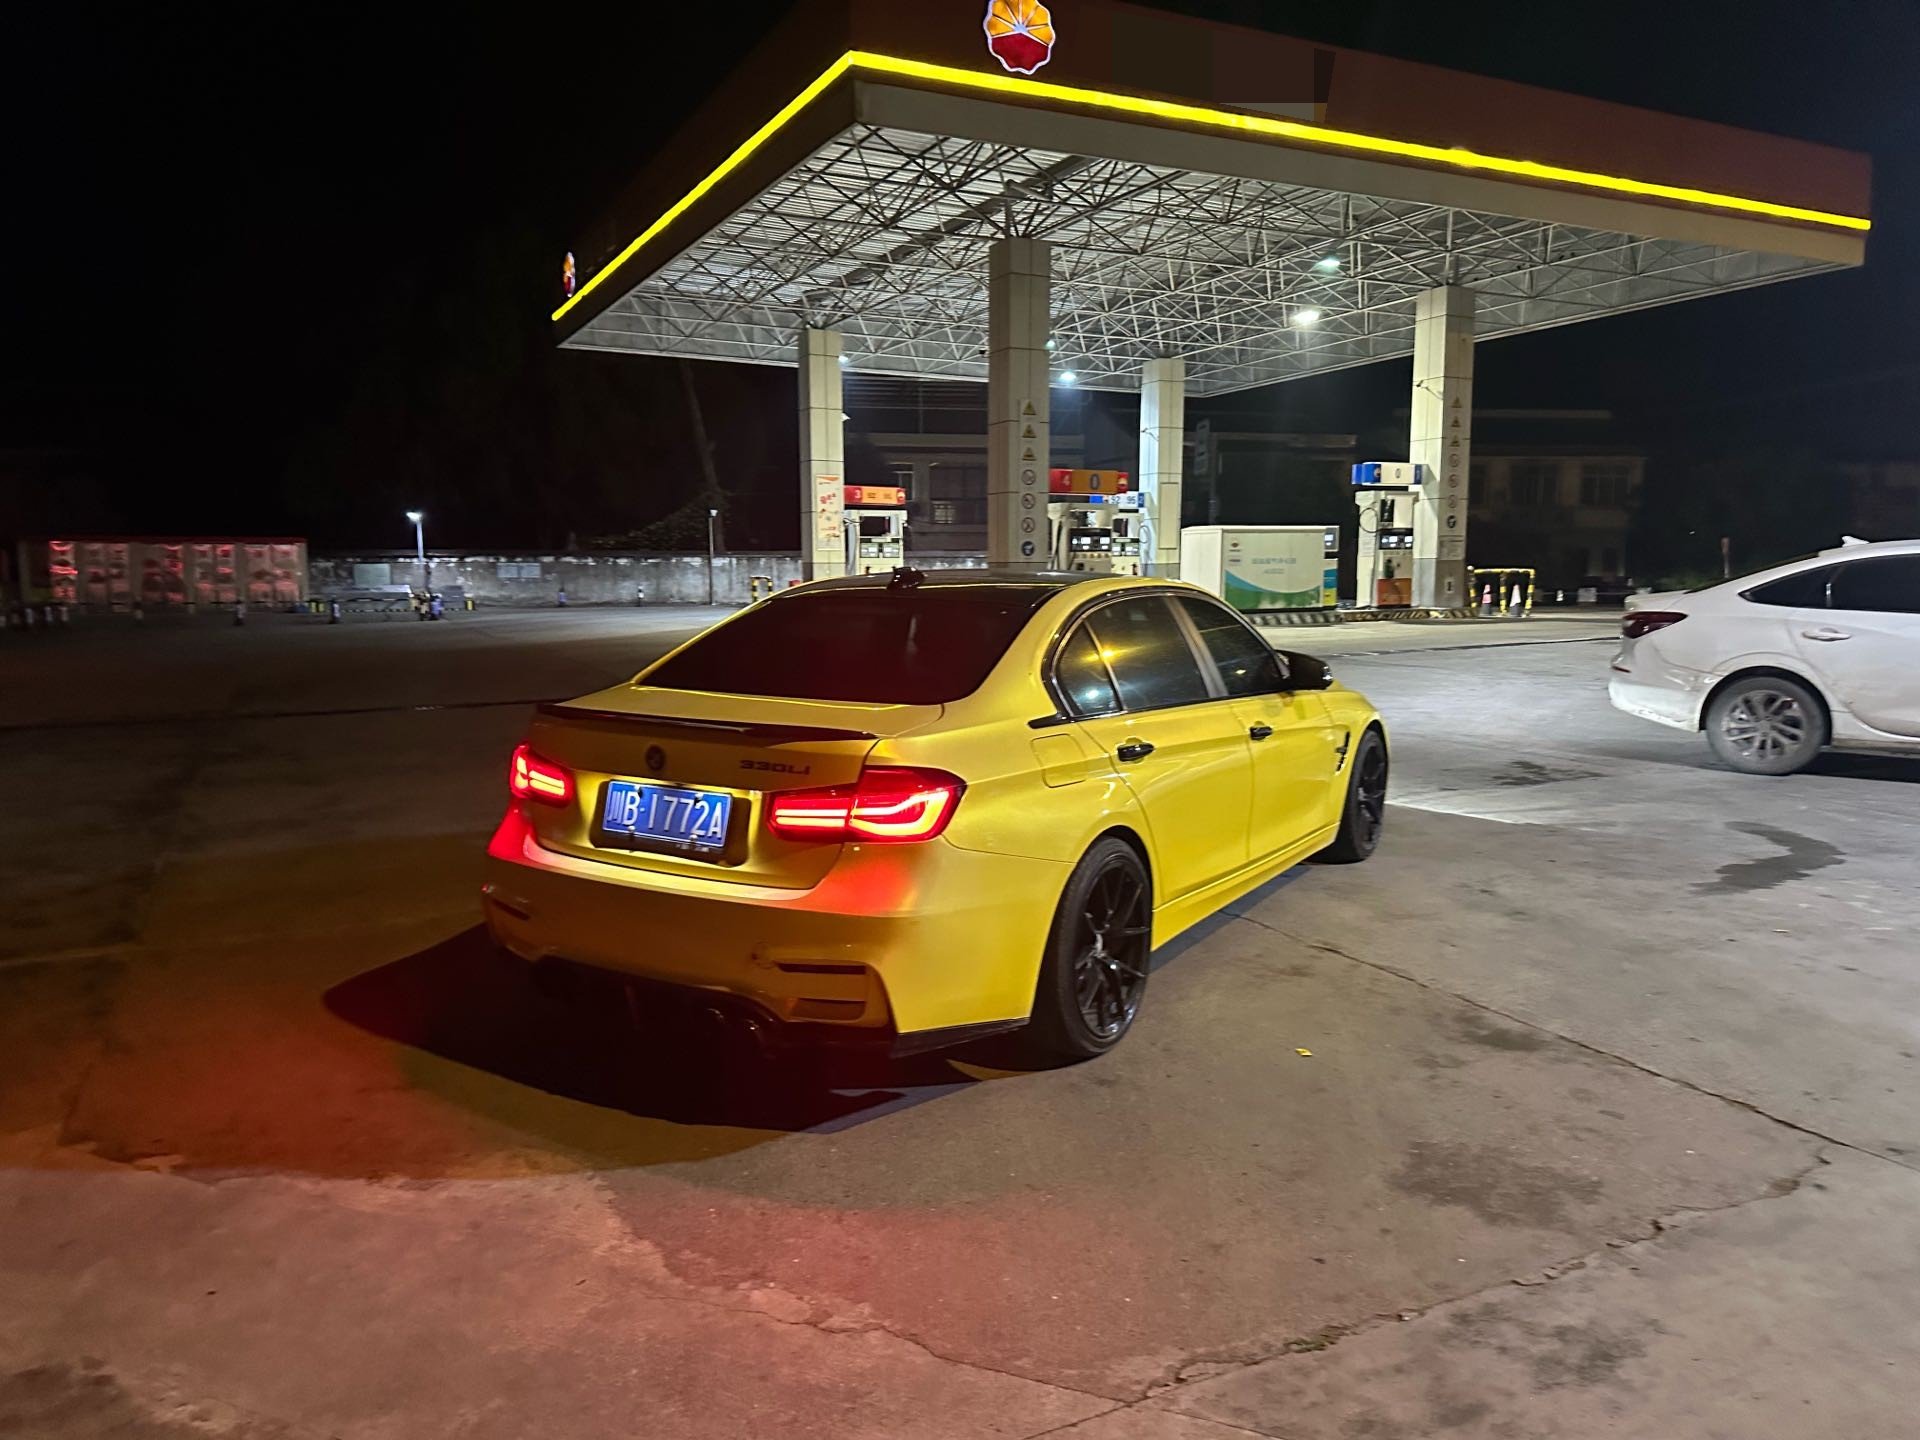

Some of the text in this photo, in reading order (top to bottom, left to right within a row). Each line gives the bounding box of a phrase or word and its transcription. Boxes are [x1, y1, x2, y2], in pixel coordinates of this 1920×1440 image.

[1062, 473, 1101, 491] 4 0
[854, 489, 862, 499] 3
